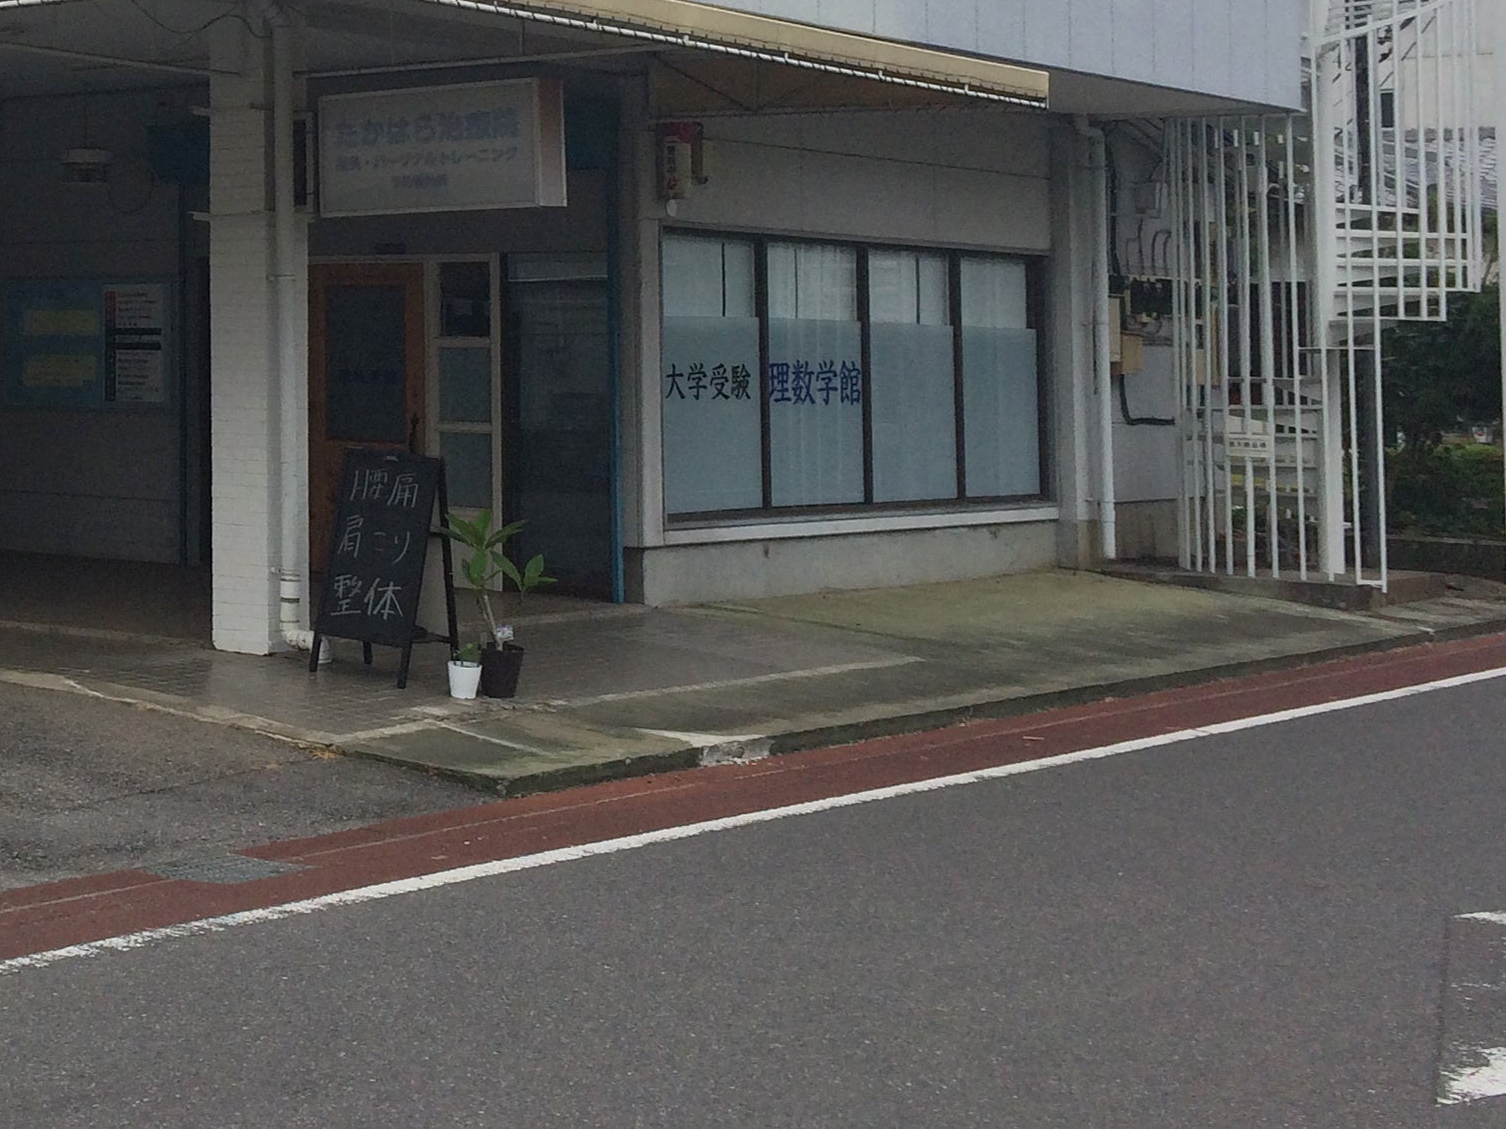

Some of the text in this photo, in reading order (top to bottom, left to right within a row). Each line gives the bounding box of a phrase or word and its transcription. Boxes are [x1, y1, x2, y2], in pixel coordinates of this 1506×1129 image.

[665, 359, 862, 405] 大学受験 理数学館
[337, 514, 411, 563] 肩こり
[330, 574, 404, 621] 整体
